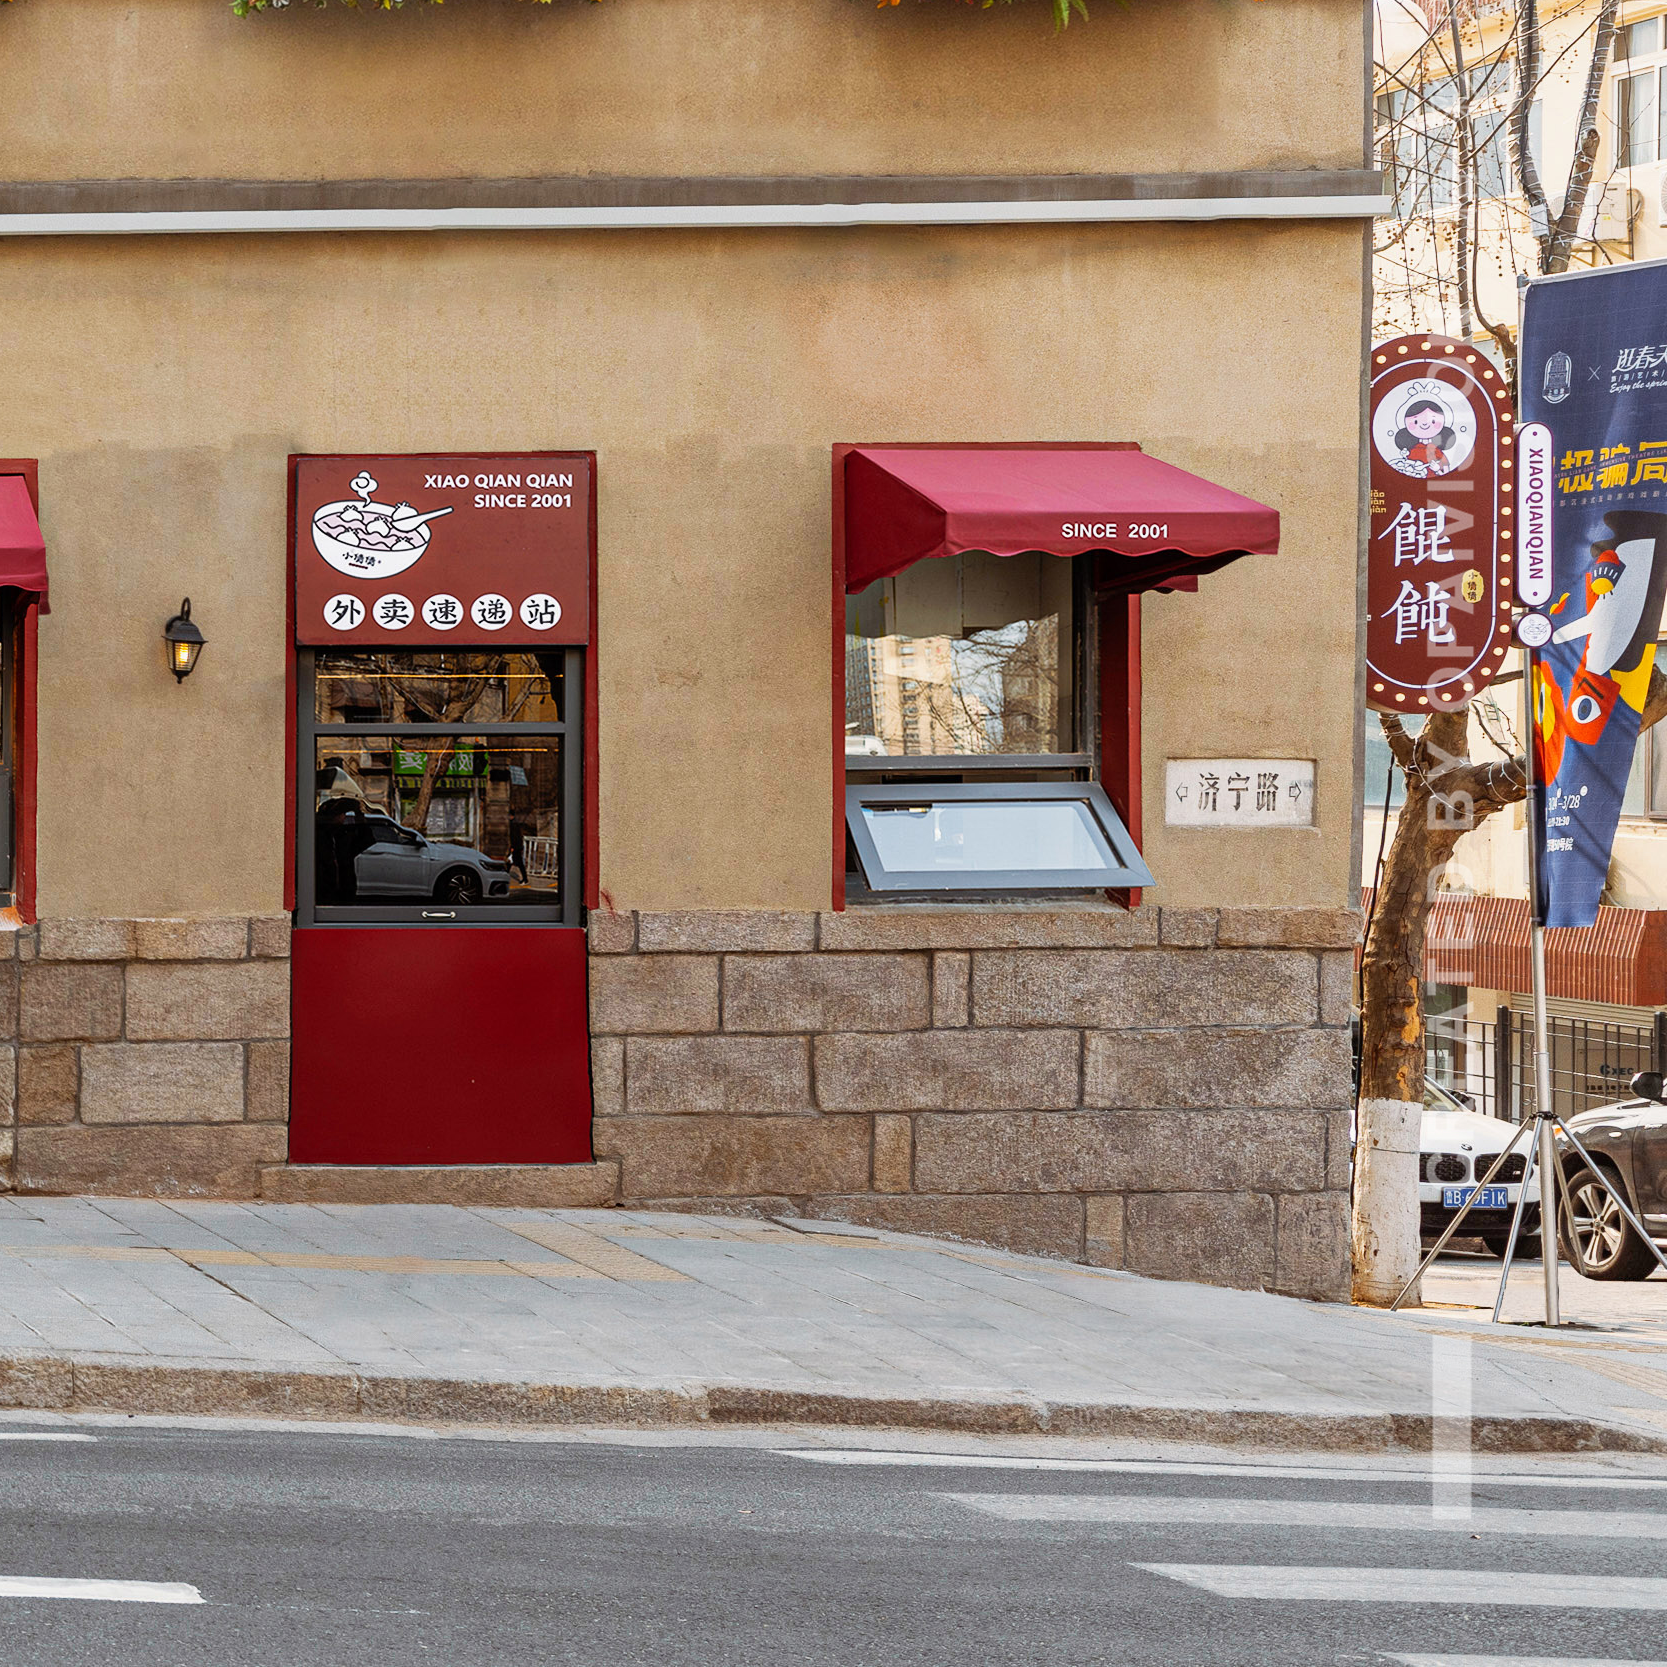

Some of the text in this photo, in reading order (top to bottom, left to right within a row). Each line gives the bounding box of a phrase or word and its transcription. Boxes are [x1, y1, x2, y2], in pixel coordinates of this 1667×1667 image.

[424, 474, 574, 491] XIAO QIAN QIAN
[474, 494, 572, 509] SINCE 2001
[1525, 448, 1544, 580] XIAOQIANQIAN
[1061, 523, 1169, 539] SINCE 2001
[1377, 502, 1455, 644] 餛飩
[331, 598, 555, 625] 外卖速递站
[1198, 771, 1279, 812] 济宁路
